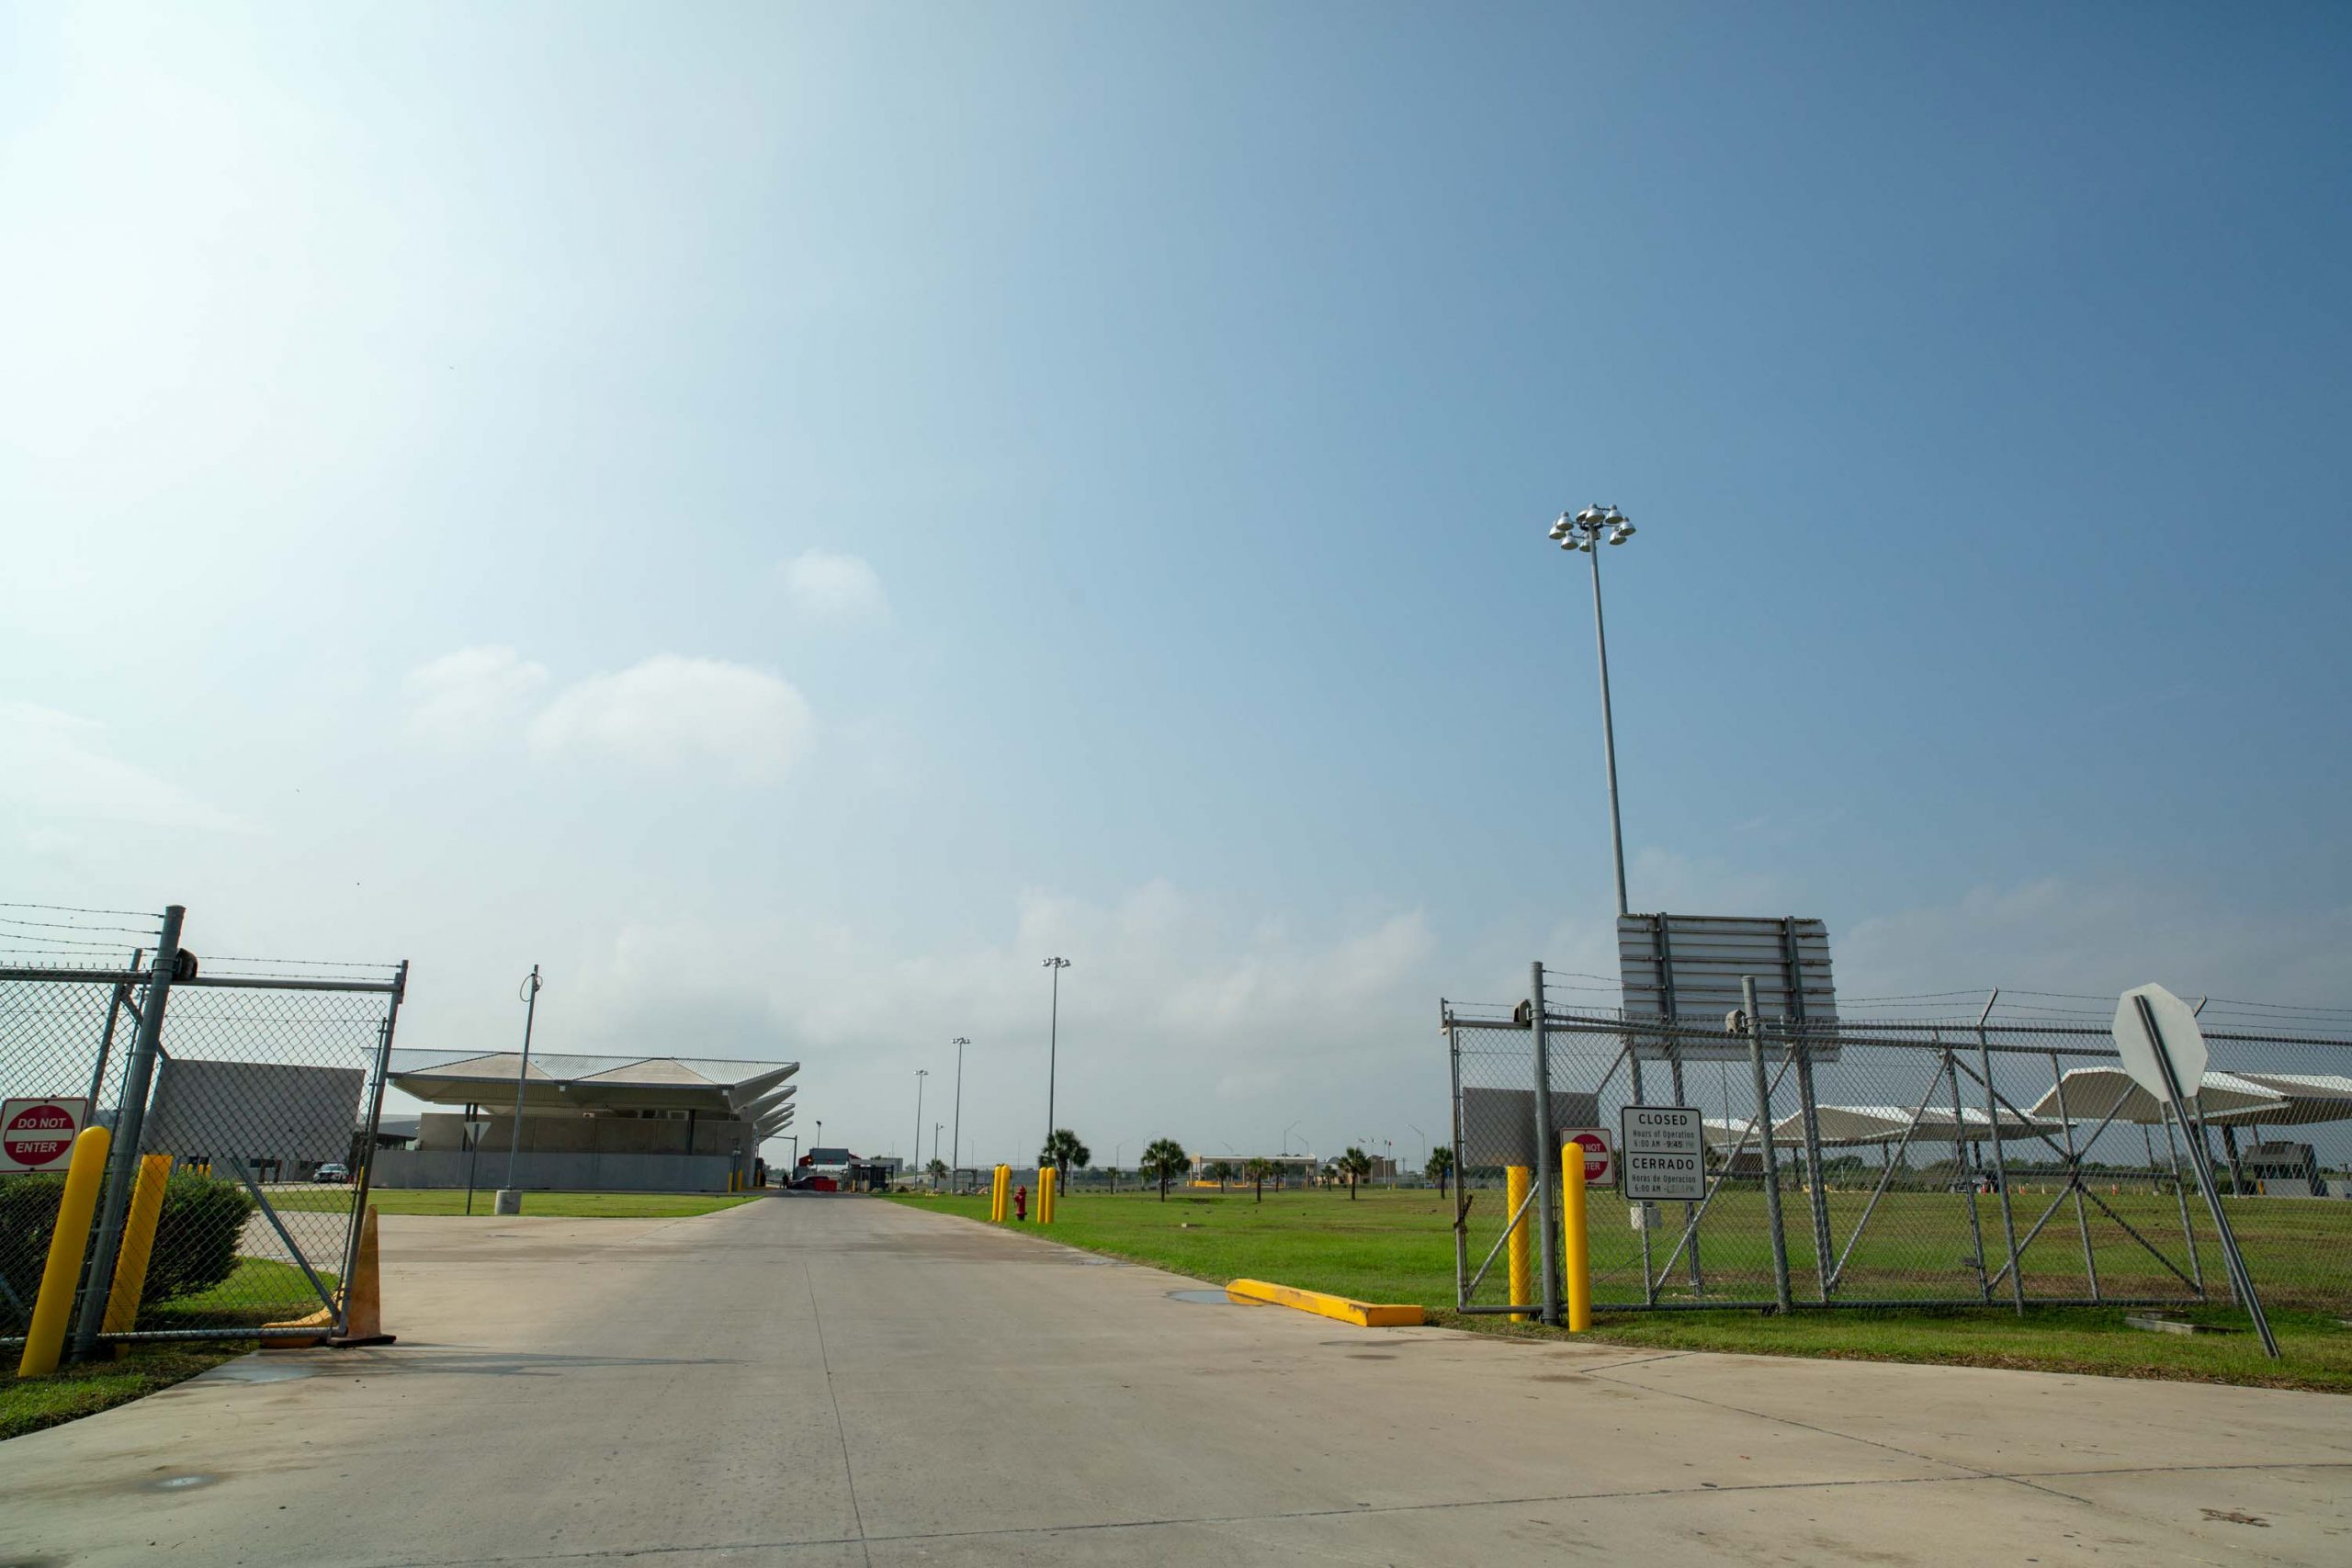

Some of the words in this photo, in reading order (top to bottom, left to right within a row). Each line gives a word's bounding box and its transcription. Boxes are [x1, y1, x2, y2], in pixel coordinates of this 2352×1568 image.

[17, 1118, 37, 1129] DO
[40, 1117, 66, 1128] NOT
[1638, 1113, 1688, 1125] CLOSED
[1633, 1130, 1652, 1138] Hours
[1654, 1130, 1660, 1138] of
[1663, 1131, 1694, 1139] Operation
[16, 1142, 58, 1154] ENTER
[1585, 1144, 1601, 1152] NOT
[1583, 1162, 1600, 1170] TER
[1632, 1158, 1694, 1170] CERRADO
